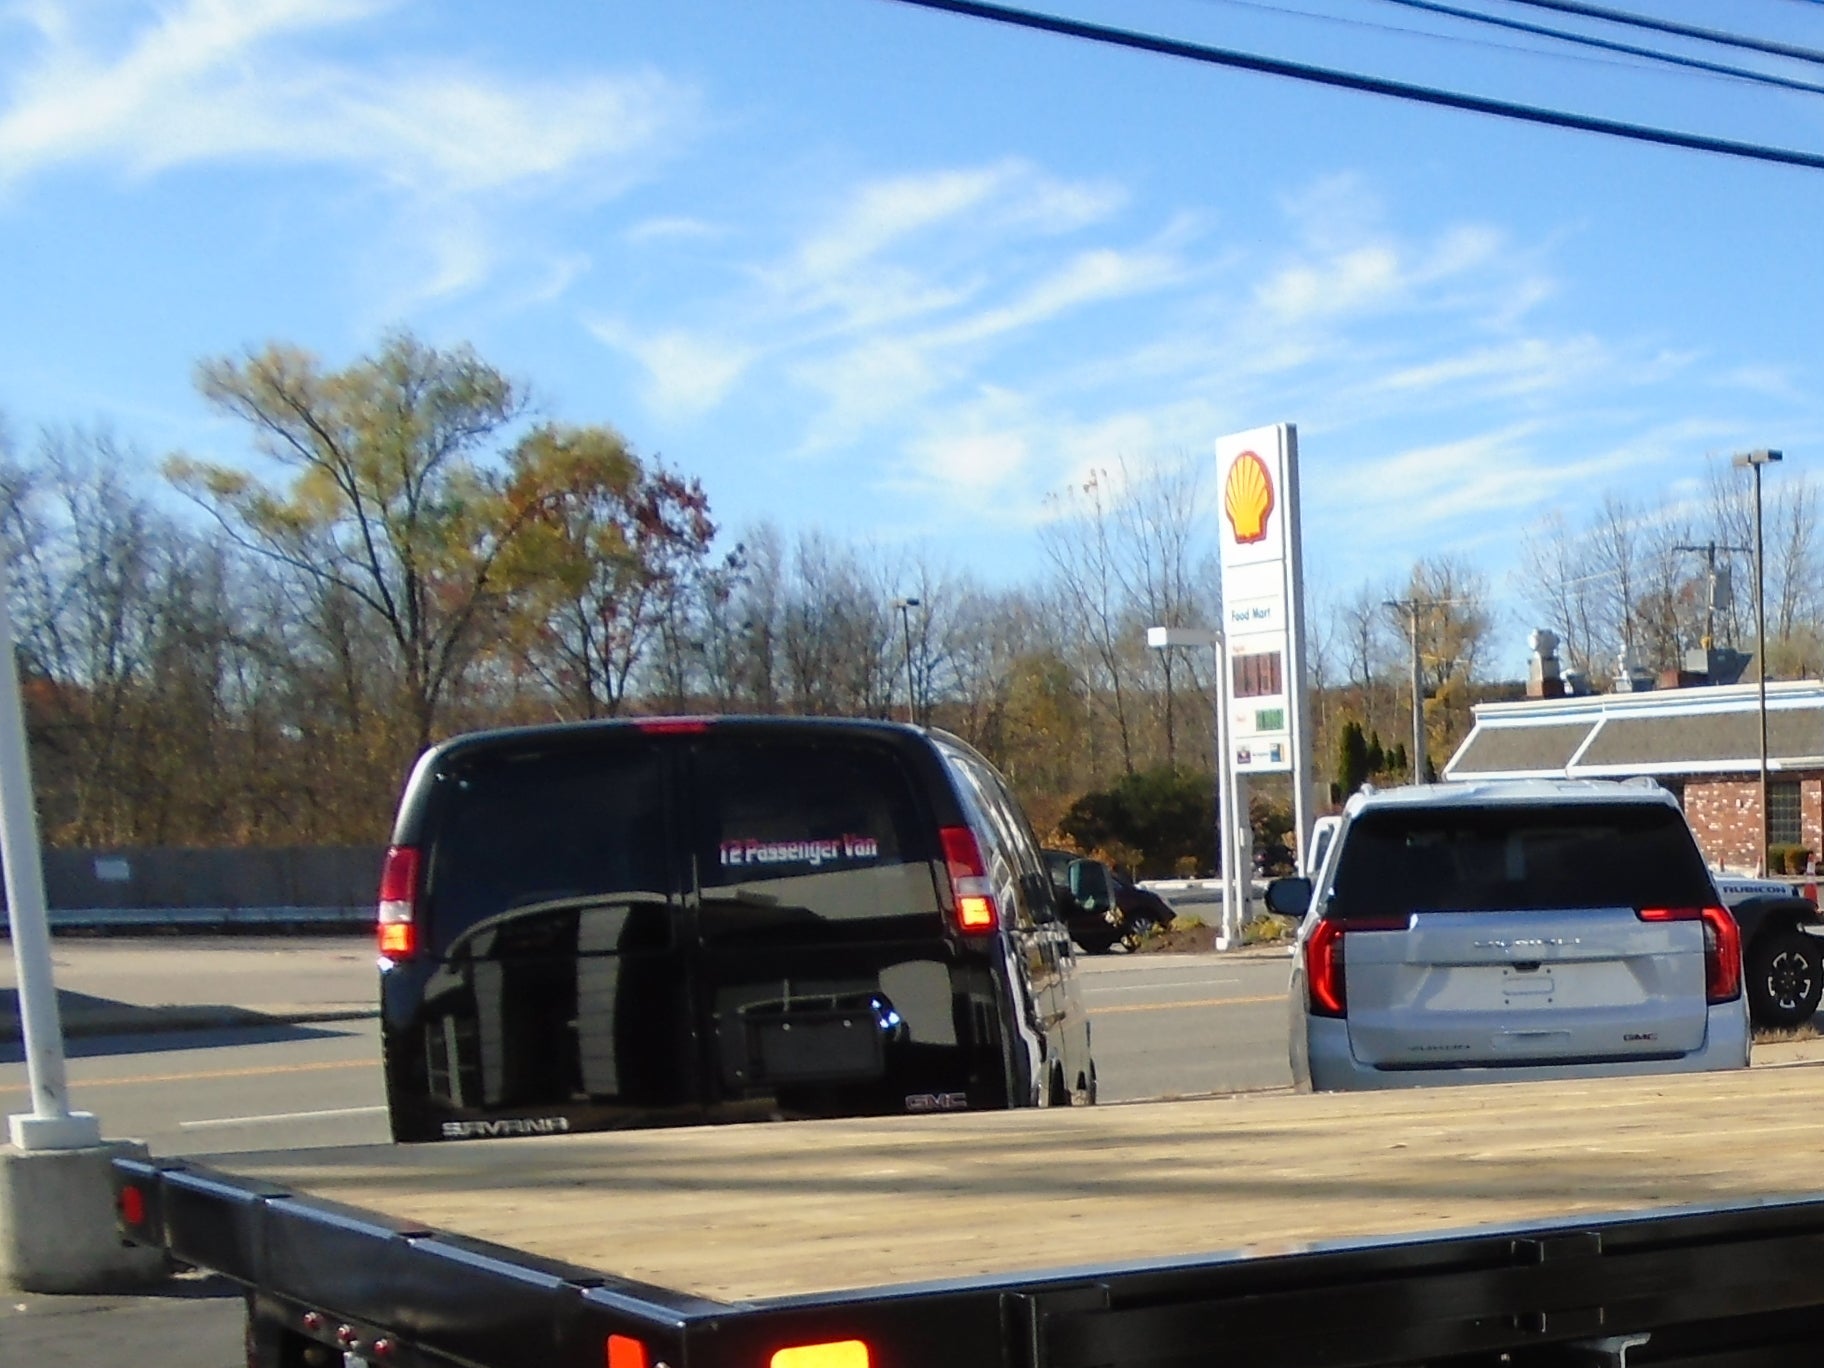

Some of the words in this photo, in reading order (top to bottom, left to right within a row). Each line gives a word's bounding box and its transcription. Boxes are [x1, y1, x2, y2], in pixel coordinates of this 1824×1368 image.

[1231, 609, 1249, 622] Food
[1252, 607, 1271, 620] Mart
[745, 838, 840, 866] Passenger
[843, 834, 878, 857] Van
[905, 1093, 967, 1110] GMC
[442, 1117, 569, 1136] SAVANA
